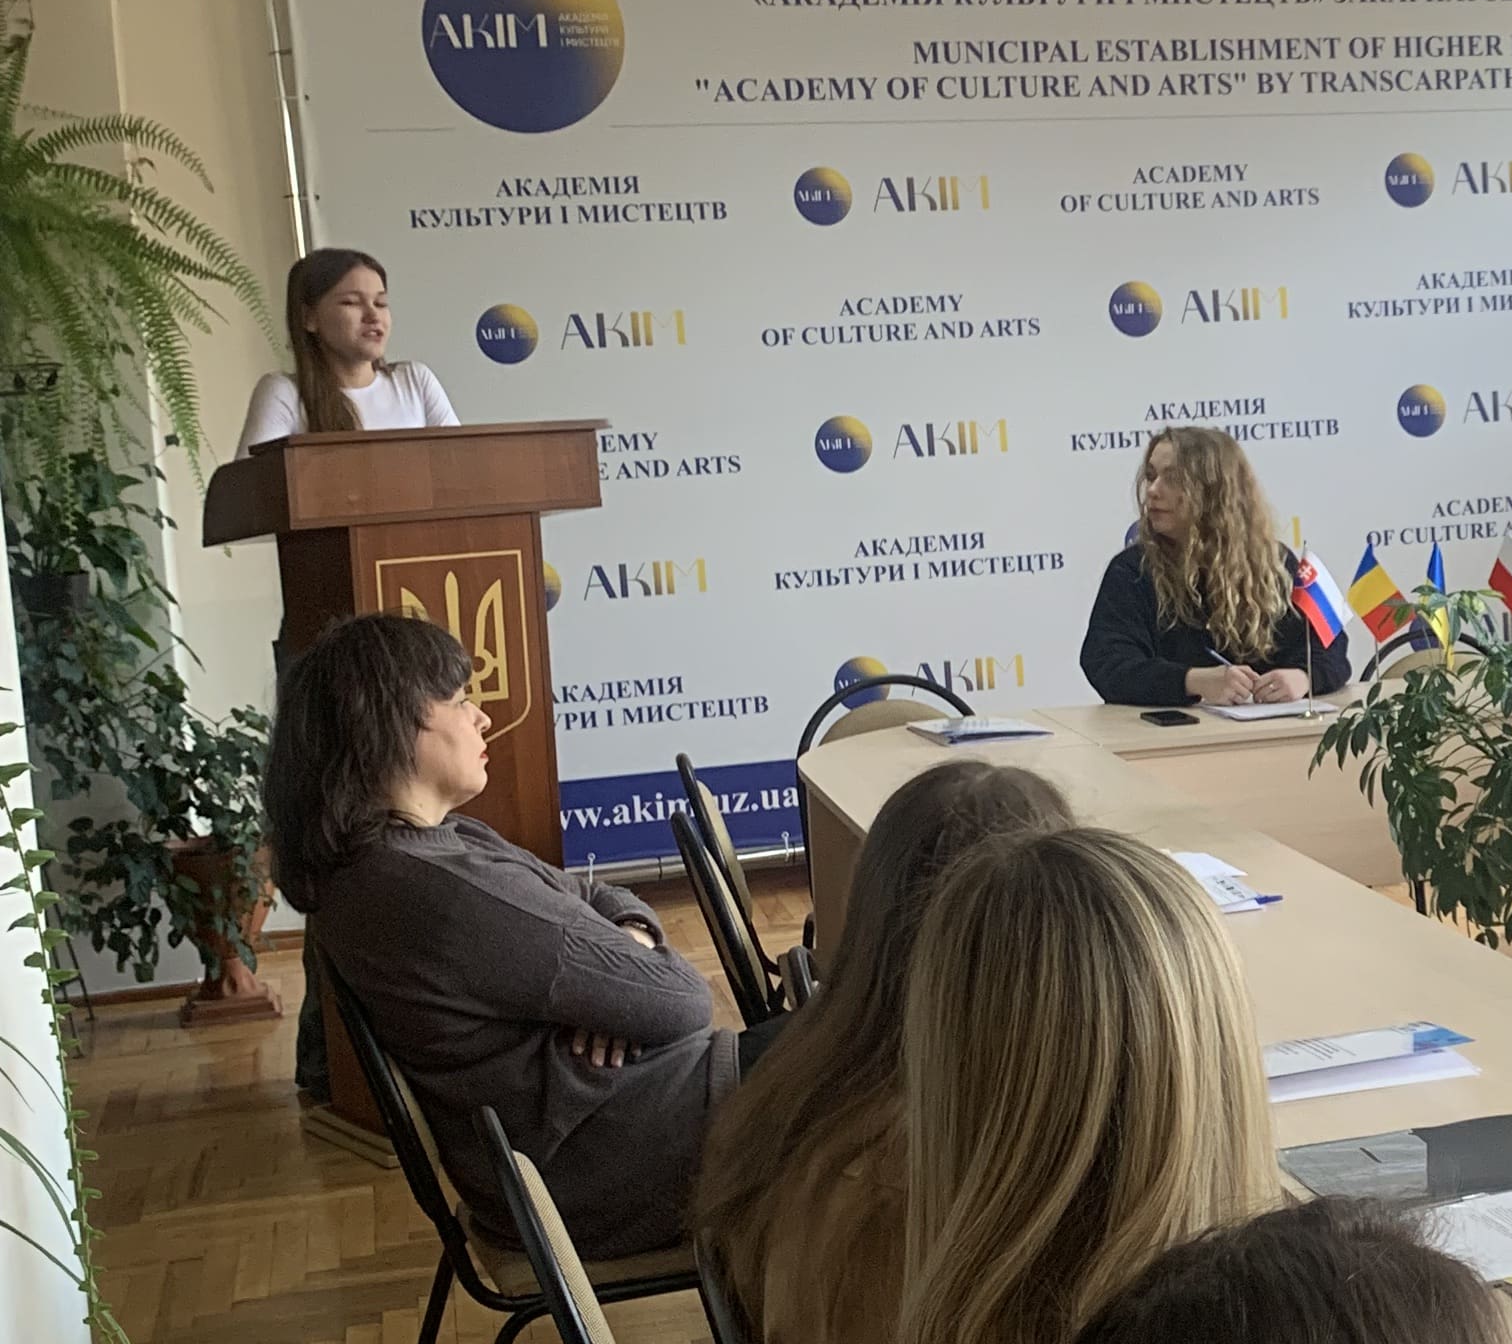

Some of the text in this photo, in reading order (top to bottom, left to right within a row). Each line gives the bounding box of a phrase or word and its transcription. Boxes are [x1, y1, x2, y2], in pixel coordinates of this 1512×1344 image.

[914, 40, 1088, 64] MUNICIPAL
[1097, 38, 1340, 62] ESTABLISHMENT
[1349, 37, 1385, 58] OF
[1394, 35, 1502, 58] HIGHER
[696, 78, 877, 102] "ACADEMY
[887, 77, 928, 100] OF
[937, 75, 1080, 99] CULTURE
[1088, 75, 1150, 97] AND
[1158, 73, 1245, 96] ARTS"
[1258, 72, 1293, 94] BY
[1133, 164, 1247, 184] ACADEMY
[496, 176, 639, 199] АКАДЕМІЯ
[1061, 189, 1319, 212] OF CULTURE AND ARTS
[411, 202, 727, 228] КУЛЬТУРИ І МИСТЕЦТВ
[840, 295, 962, 316] ACADEMY
[1348, 297, 1459, 318] КУЛЬТУРИ
[1467, 296, 1472, 312] І
[762, 319, 1040, 346] OF CULTURE AND ARTS
[1145, 398, 1265, 421] АКАДЕМІЯ
[616, 459, 669, 480] AND
[677, 455, 741, 476] ARTS
[855, 532, 984, 557] АКАДЕМІЯ
[1367, 530, 1395, 548] OF
[1400, 522, 1497, 544] CULTURE
[776, 553, 1064, 589] КУЛЬТУРИ І МИСТЕЦТВ
[623, 696, 769, 725] МИСТЕЦТВ
